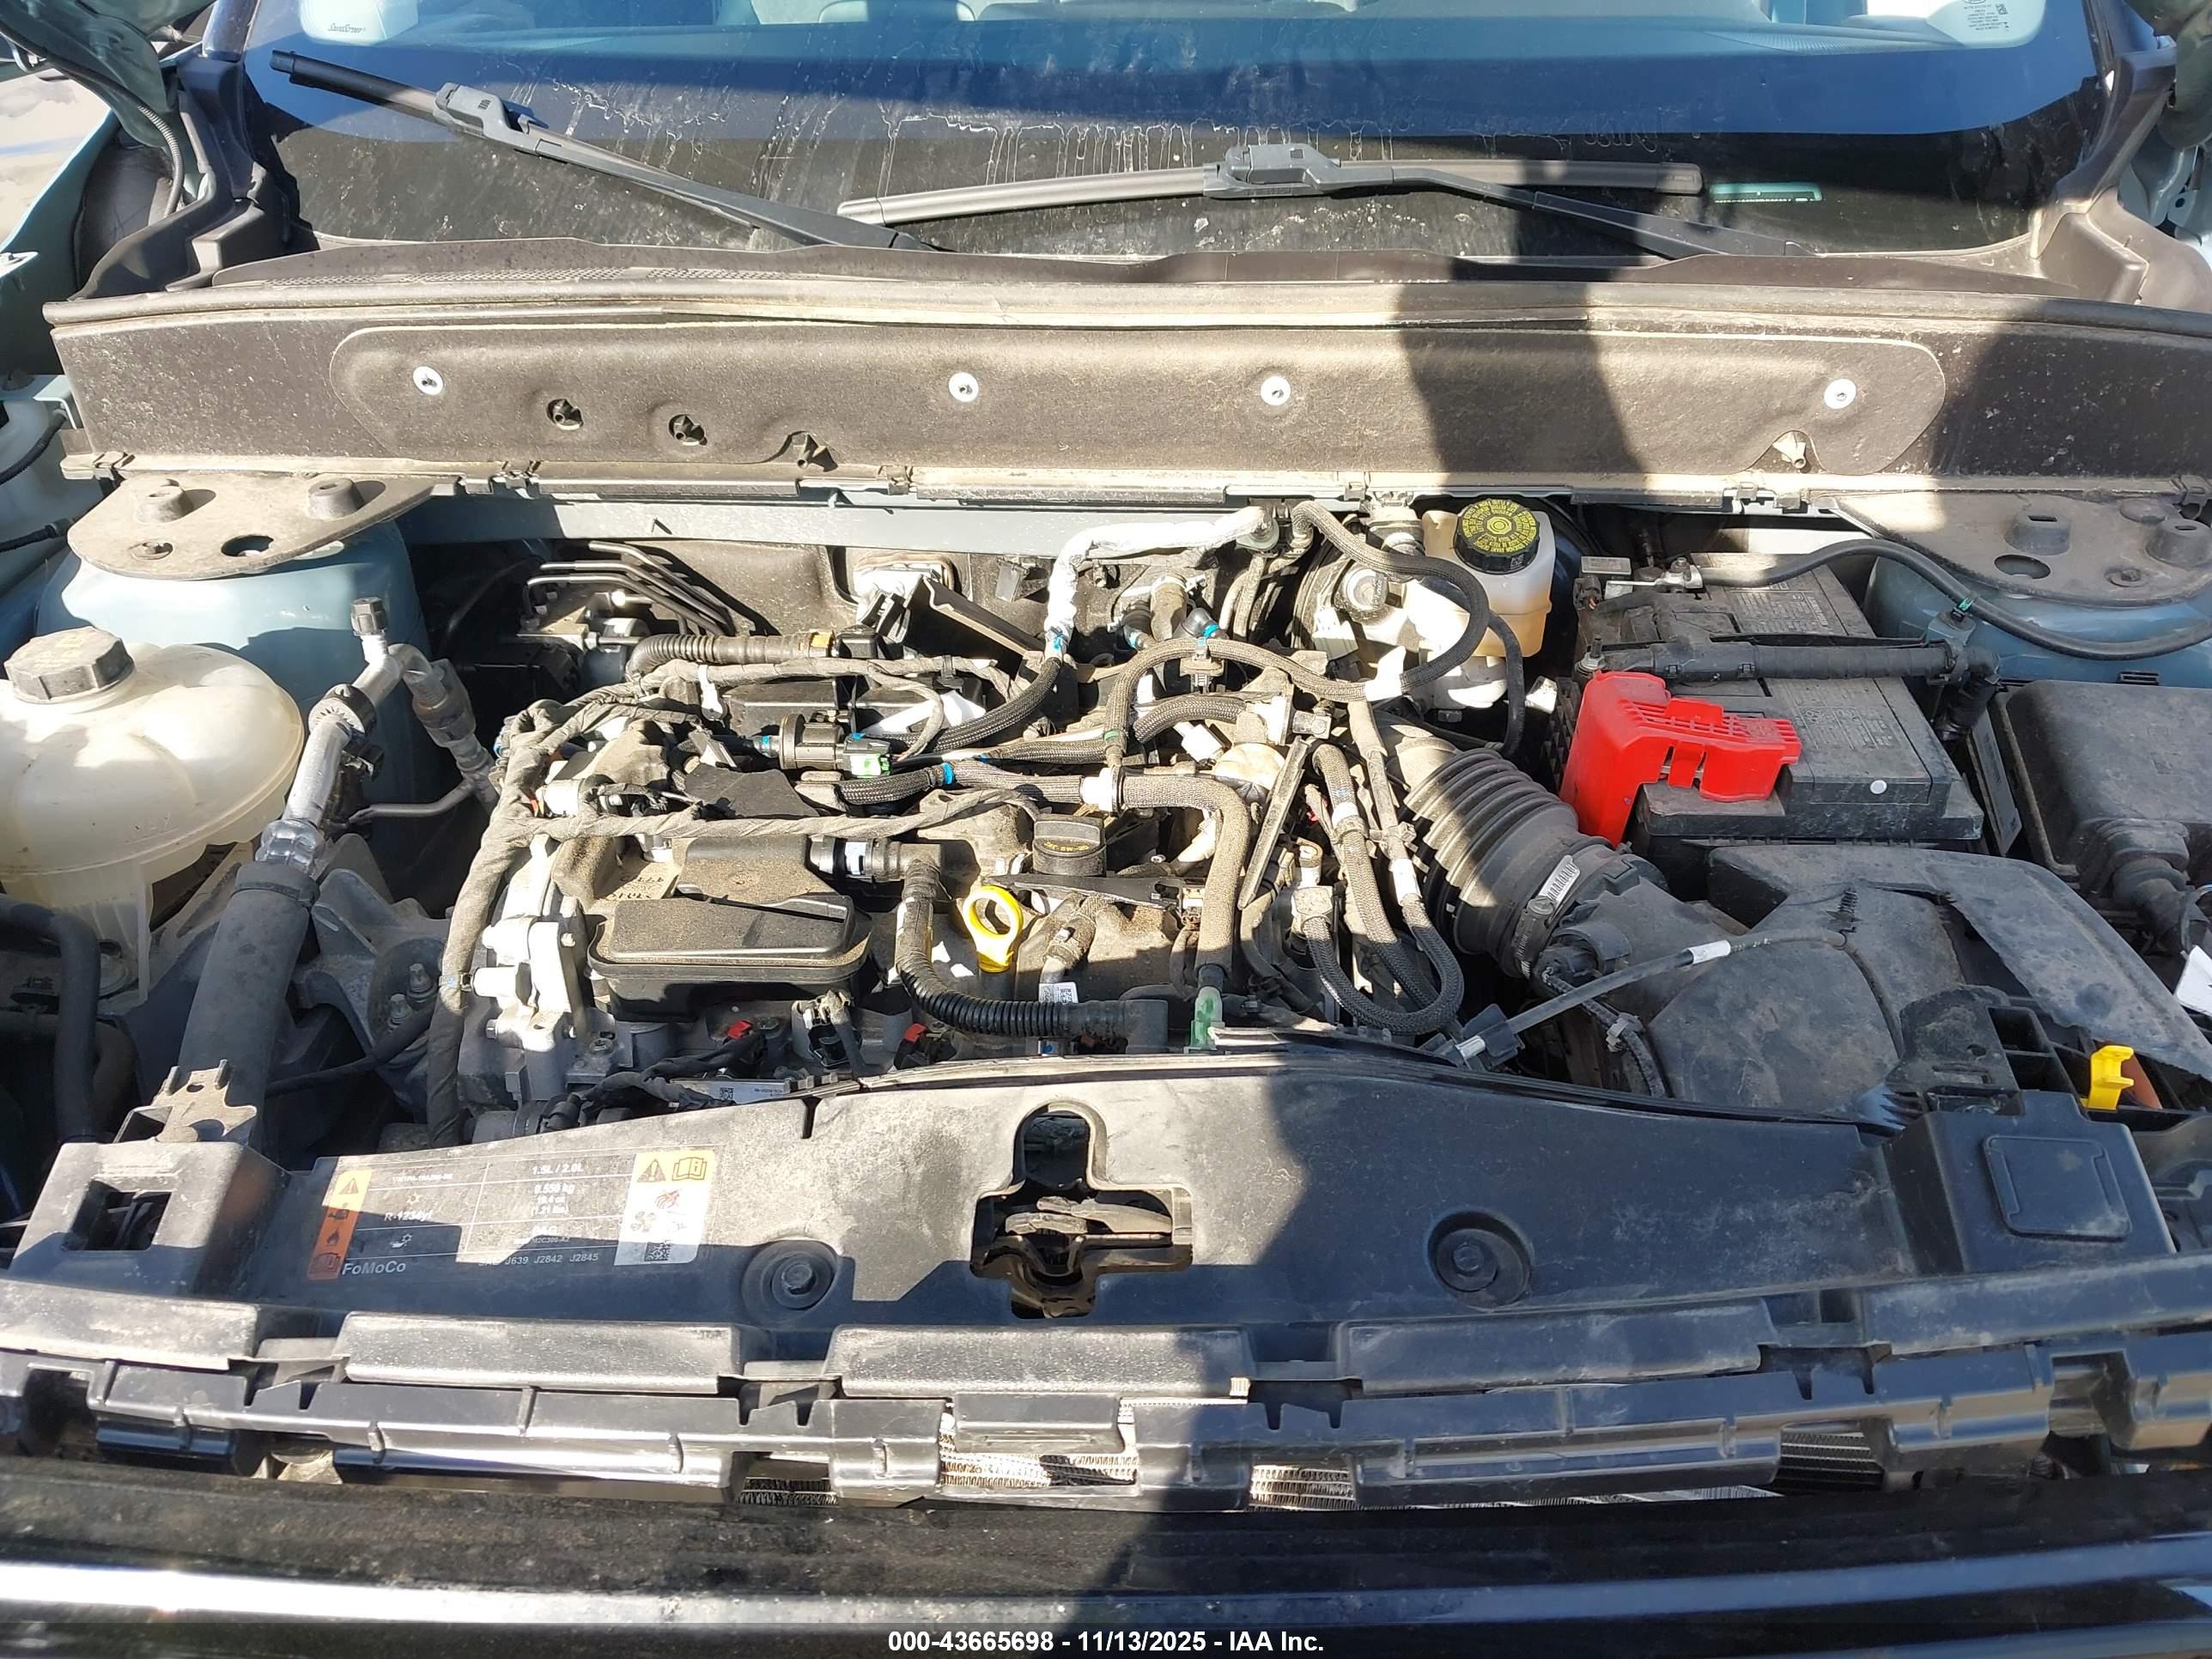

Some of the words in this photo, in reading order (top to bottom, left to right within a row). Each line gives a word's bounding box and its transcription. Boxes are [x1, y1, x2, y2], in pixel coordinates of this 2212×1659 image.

[532, 1164, 553, 1176] 1.5L
[561, 1163, 584, 1174] 2.0L
[562, 1183, 575, 1195] kg
[384, 1209, 434, 1223] R-1234yf
[505, 1255, 529, 1266] J639
[533, 1255, 563, 1265] J2842
[569, 1253, 599, 1263] J2845
[341, 1261, 407, 1276] FoMoCo
